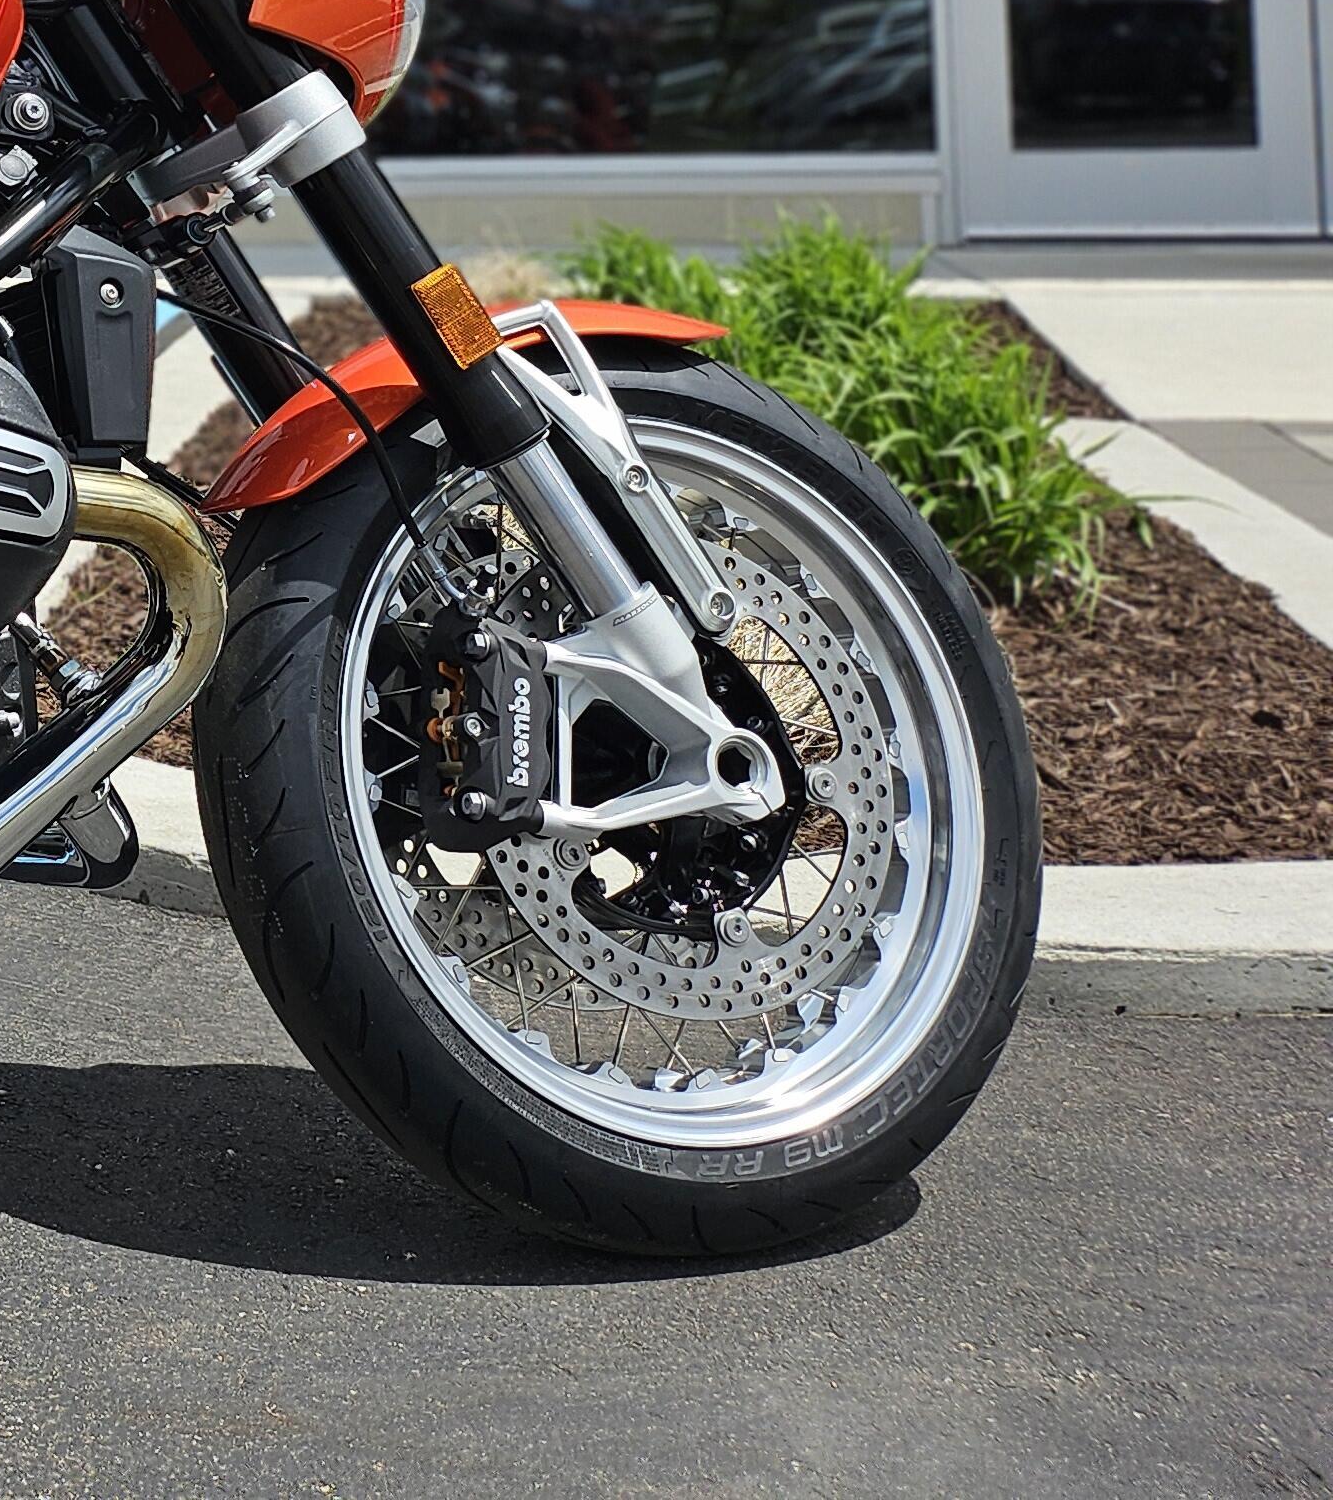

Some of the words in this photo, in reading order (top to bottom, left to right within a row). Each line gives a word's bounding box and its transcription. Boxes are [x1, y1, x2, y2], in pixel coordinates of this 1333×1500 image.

[506, 677, 531, 788] brembo
[856, 946, 1002, 1135] SPORTEC
[694, 1149, 768, 1178] RR
